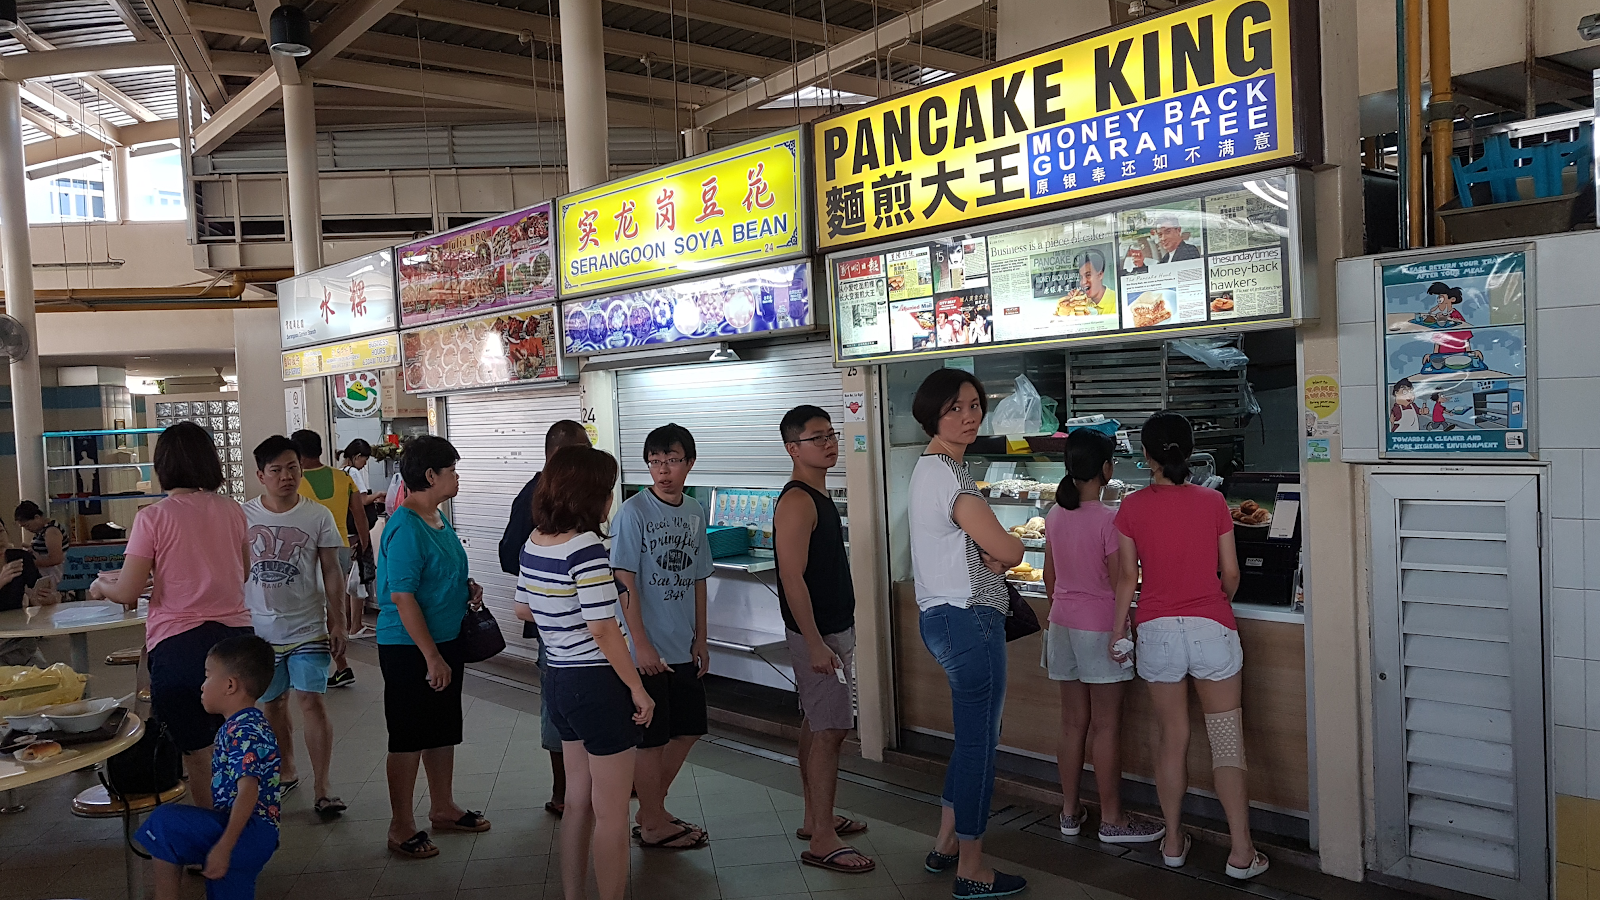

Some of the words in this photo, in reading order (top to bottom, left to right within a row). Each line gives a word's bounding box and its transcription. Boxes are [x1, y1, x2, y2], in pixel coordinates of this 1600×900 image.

[825, 59, 1066, 181] PANCAKE
[1094, 0, 1274, 113] KING
[1032, 109, 1145, 155] MONEY
[1165, 78, 1269, 125] BACK
[1033, 105, 1270, 176] GUARANTEE
[1035, 132, 1272, 196] 原银奉还如不满意
[825, 144, 1025, 240] 麵煎大王
[577, 161, 775, 252] 实龙岗豆花
[447, 238, 467, 250] Julia
[470, 230, 488, 244] BBQ
[570, 241, 666, 277] SERANGOON
[673, 229, 723, 255] SOYA
[733, 214, 788, 243] BEAN
[764, 243, 774, 253] 24
[990, 245, 1028, 257] Business
[1029, 241, 1037, 251] is
[1045, 237, 1070, 252] piece
[1071, 232, 1081, 243] of
[1082, 231, 1105, 243] cake
[935, 251, 945, 263] 15
[1033, 255, 1071, 267] PANCAKE
[1210, 261, 1279, 278] Money-back
[1429, 262, 1457, 271] RETURN
[1459, 260, 1479, 268] YOUR
[1416, 270, 1439, 279] AFTER
[1441, 269, 1460, 277] YOUR
[1211, 276, 1258, 291] hawkers
[320, 278, 368, 325] 水粿
[847, 366, 858, 377] 25
[1305, 385, 1336, 393] TAKE
[582, 407, 596, 423] 24
[253, 560, 298, 576] DELUXE
[260, 582, 283, 590] RAND
